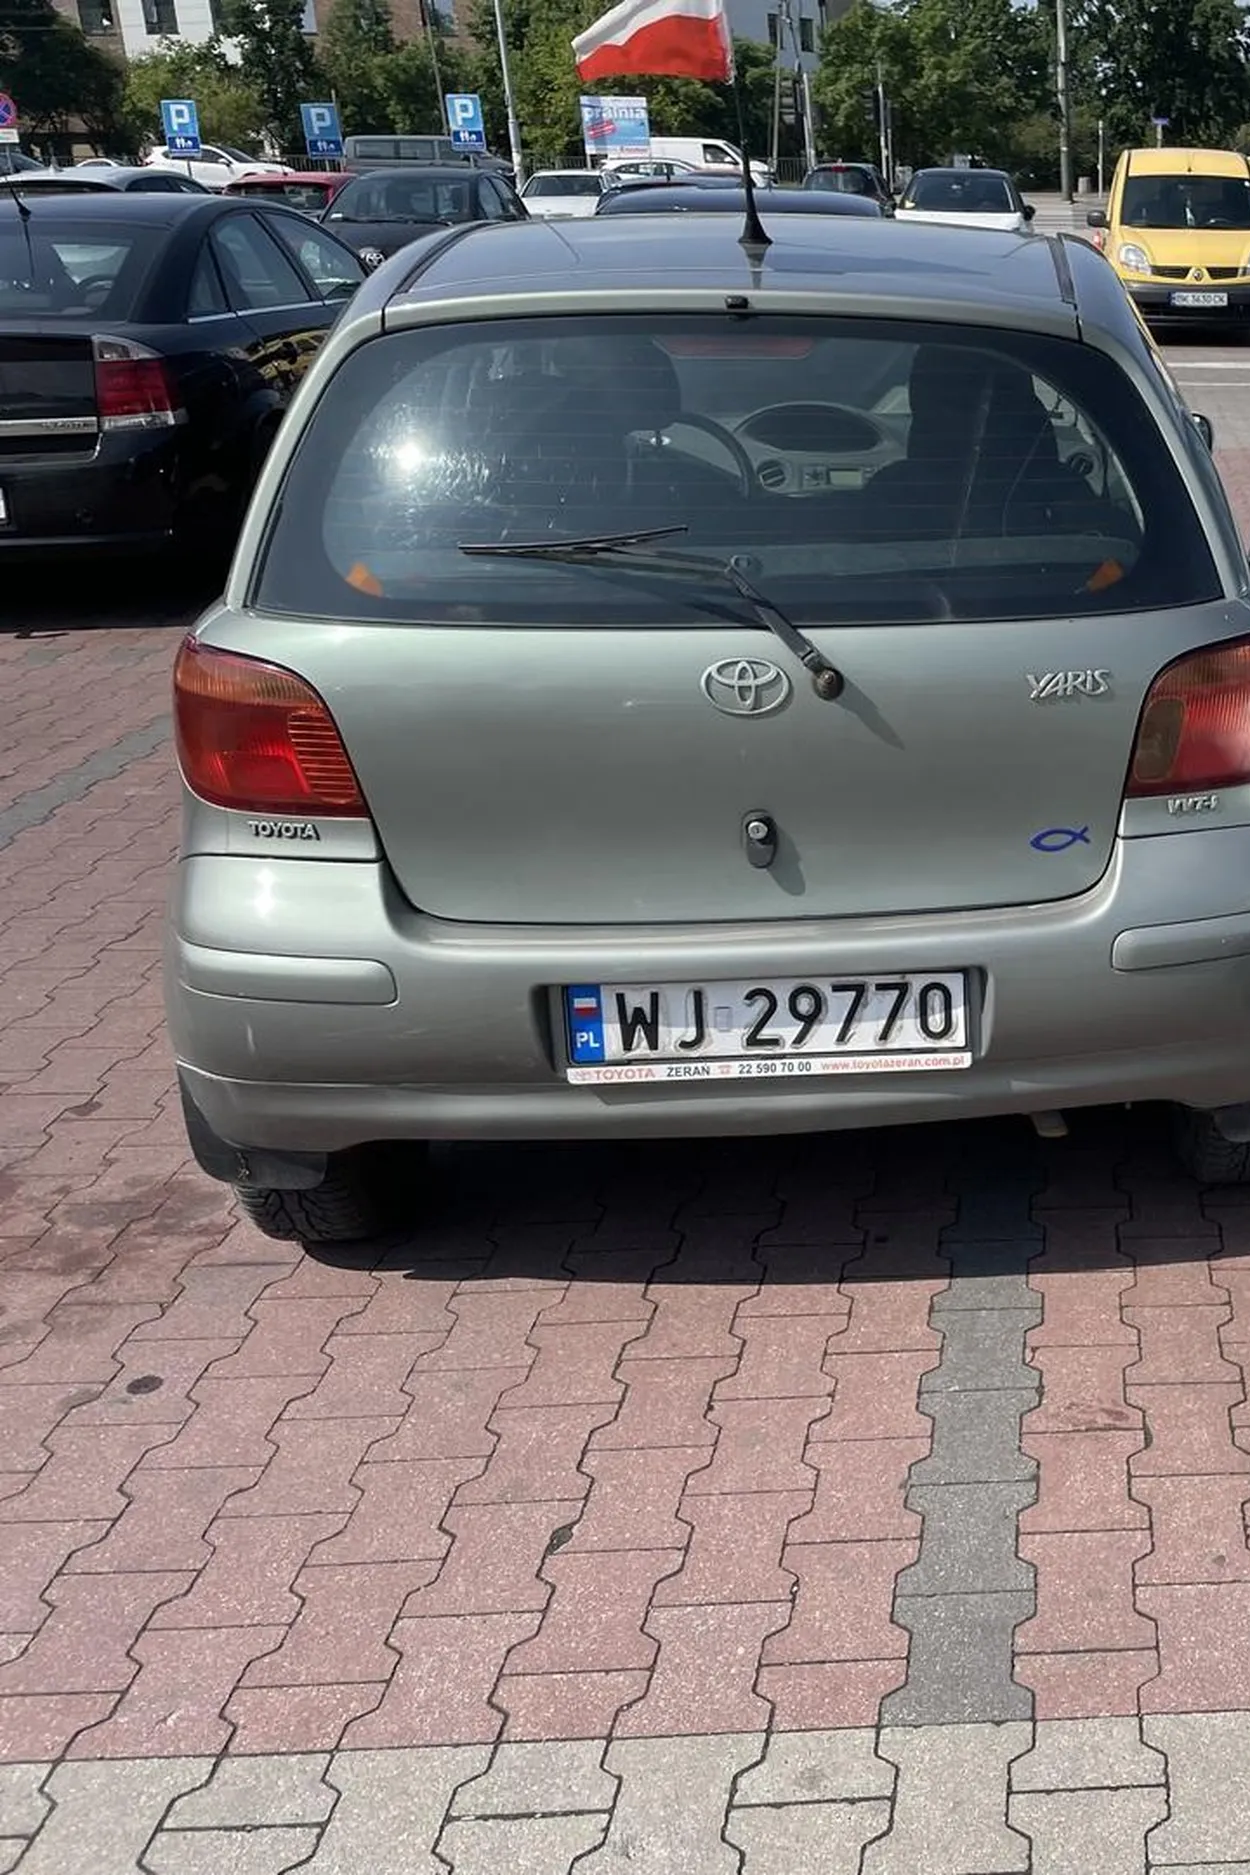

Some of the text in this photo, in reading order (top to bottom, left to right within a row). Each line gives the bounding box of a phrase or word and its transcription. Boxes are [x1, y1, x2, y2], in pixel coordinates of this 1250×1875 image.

[169, 104, 191, 131] P
[309, 107, 331, 134] P
[453, 98, 475, 126] P
[247, 820, 320, 841] TOYOTA
[614, 981, 954, 1052] WJ 29770
[576, 1031, 600, 1049] PL
[593, 1067, 656, 1081] TOYOTA
[738, 1063, 753, 1075] 22
[756, 1062, 778, 1074] 590
[781, 1061, 795, 1073] 70
[797, 1061, 812, 1072] 00
[821, 1055, 965, 1071] www.toyotazeran.com.pl
